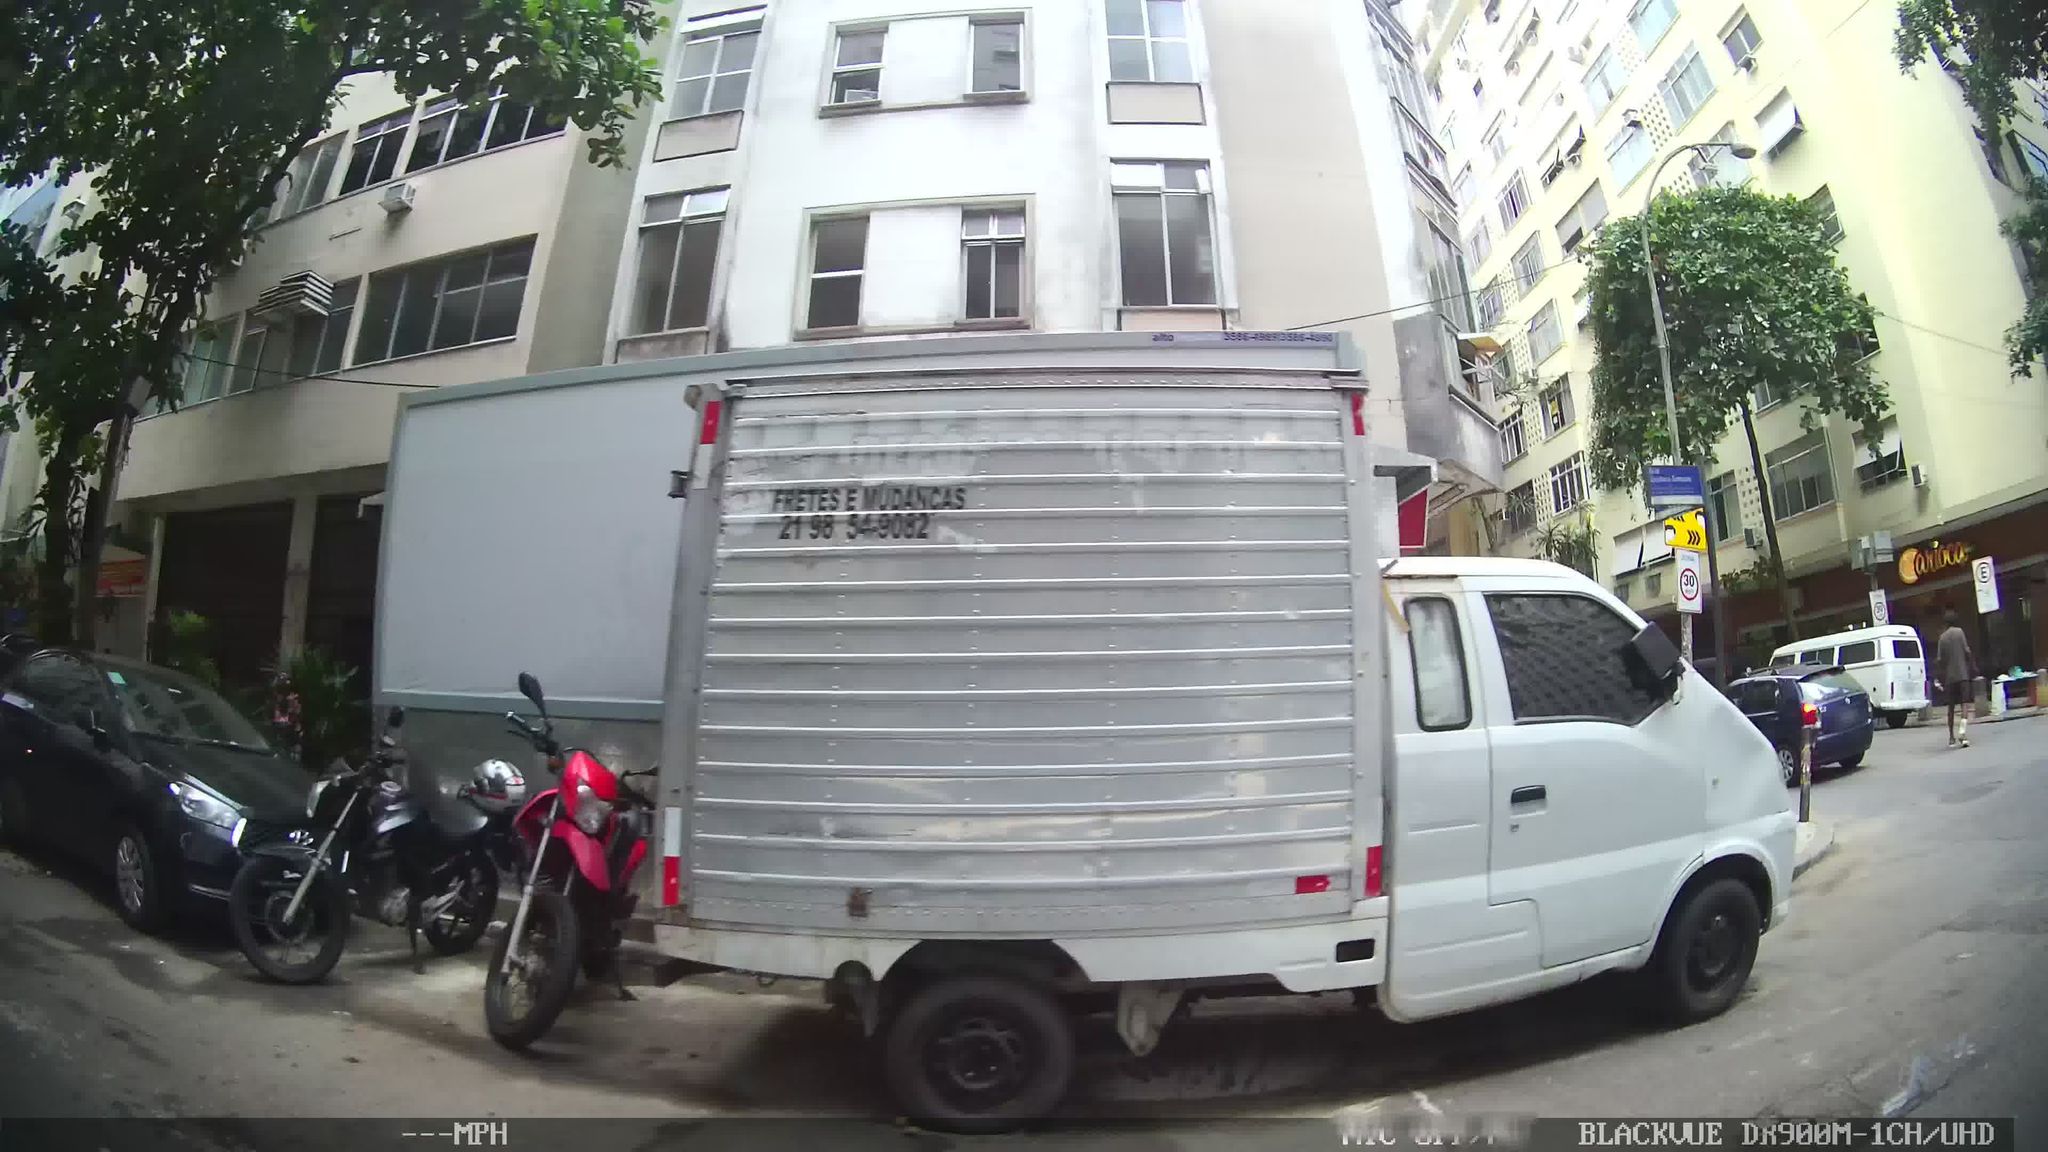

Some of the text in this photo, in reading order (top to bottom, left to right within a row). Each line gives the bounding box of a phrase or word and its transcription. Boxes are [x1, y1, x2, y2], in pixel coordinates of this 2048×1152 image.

[771, 489, 840, 517] FRETES
[848, 489, 858, 513] E
[778, 514, 800, 540] 21
[1683, 574, 1695, 588] 30
[1980, 566, 1988, 579] E
